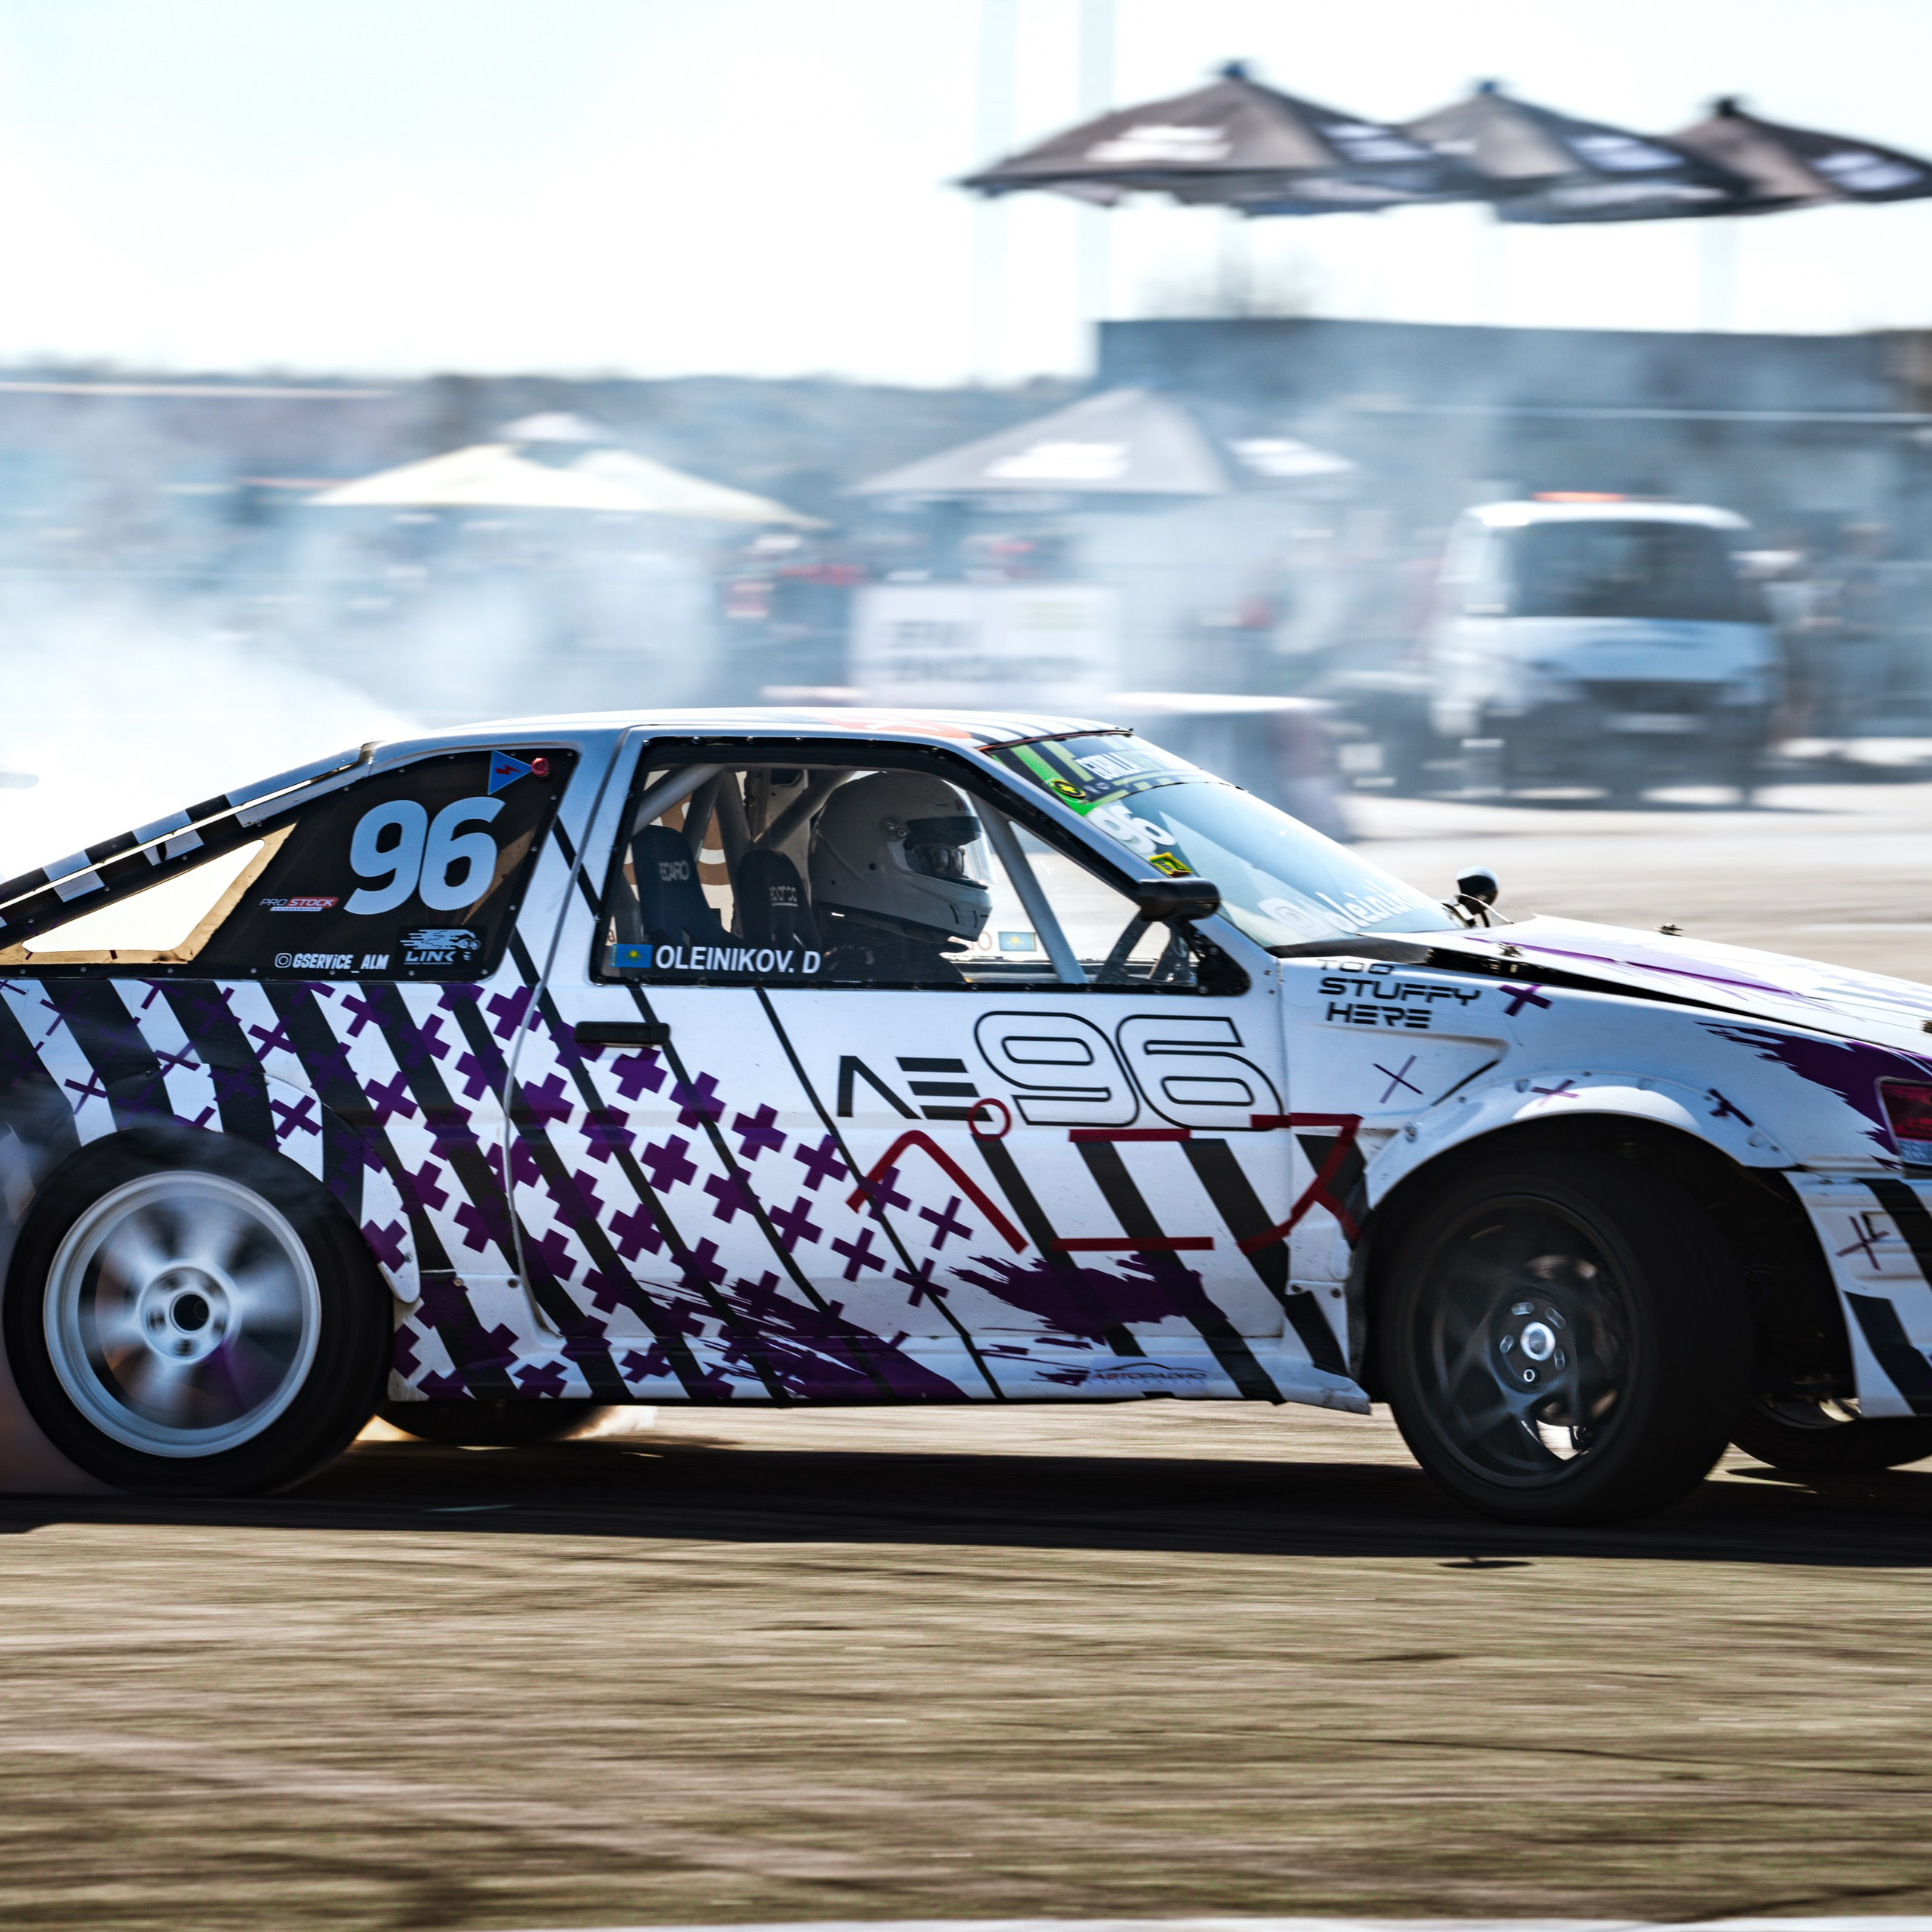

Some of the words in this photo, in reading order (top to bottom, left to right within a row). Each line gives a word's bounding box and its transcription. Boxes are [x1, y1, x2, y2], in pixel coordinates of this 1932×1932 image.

[1088, 804, 1177, 854] 96
[343, 796, 506, 915] 96
[259, 898, 288, 906] PRO
[288, 898, 337, 906] STOCK
[405, 951, 457, 962] LINK
[655, 945, 795, 973] OLEINIKOV.
[801, 951, 821, 974] D
[1318, 959, 1395, 975] TOO
[1318, 977, 1481, 1006] STUFFY
[1326, 1001, 1432, 1029] HERE
